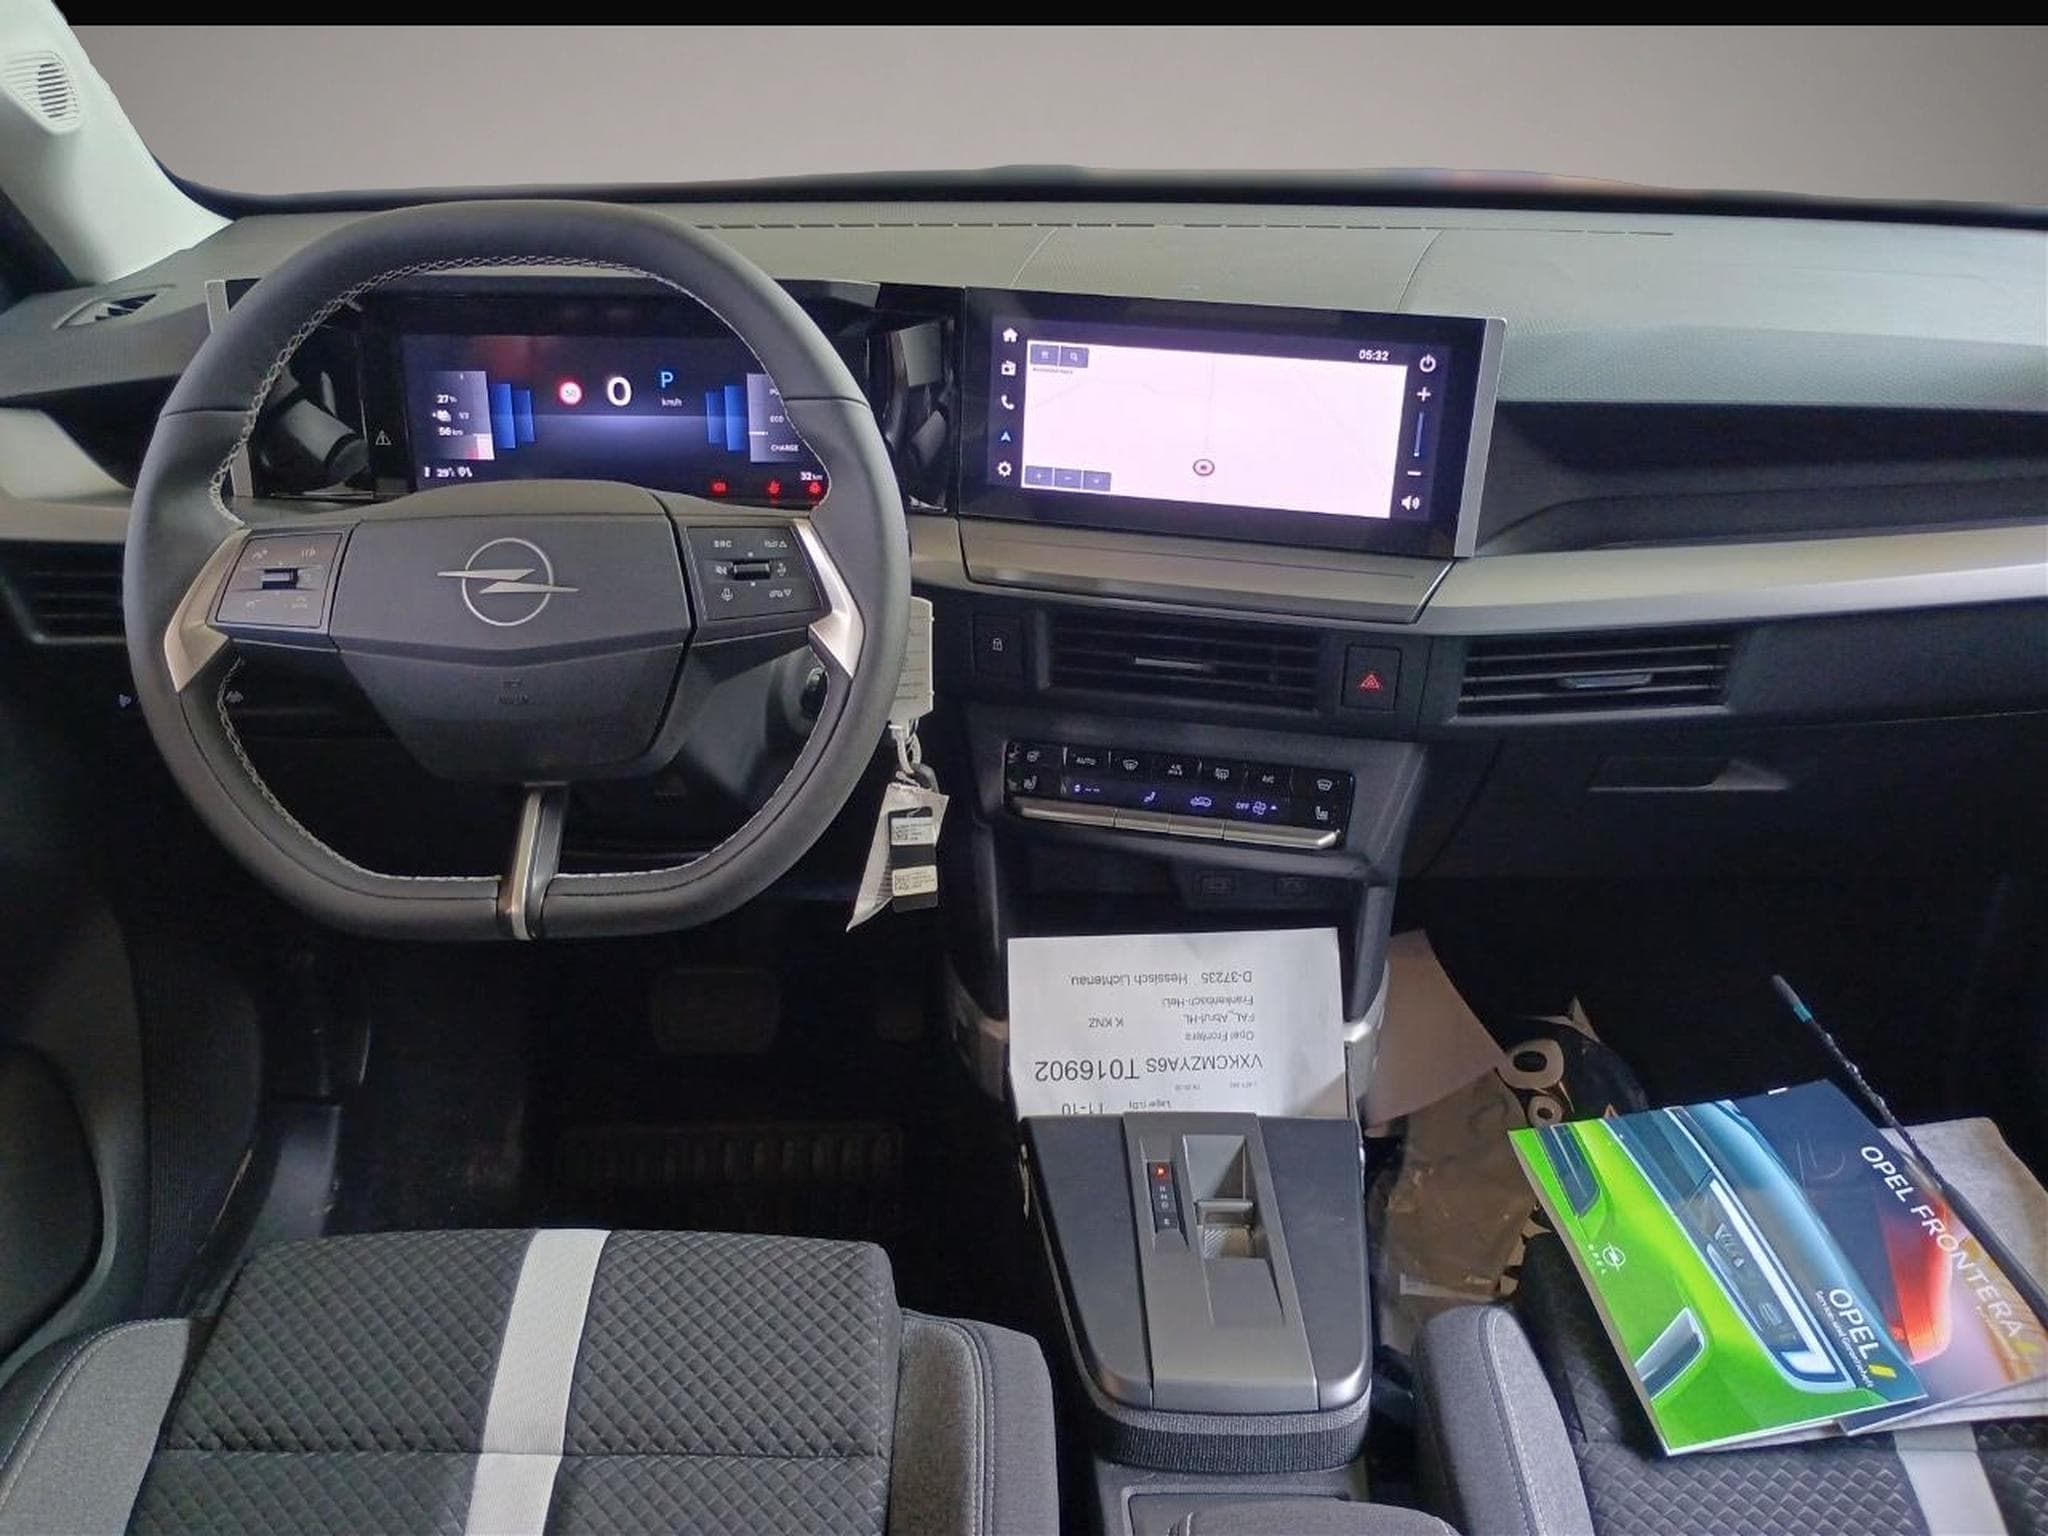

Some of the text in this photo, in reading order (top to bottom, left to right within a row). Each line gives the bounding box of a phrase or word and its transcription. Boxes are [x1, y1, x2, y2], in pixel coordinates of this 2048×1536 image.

[1358, 349, 1389, 361] 05:32
[660, 371, 674, 388] P
[606, 376, 632, 406] 0
[661, 398, 682, 407] km/h
[770, 444, 799, 452] CHARGE
[1235, 802, 1250, 810] OFF
[1133, 973, 1188, 985] Hessisch
[1200, 970, 1253, 985] D-37235
[1034, 1053, 1263, 1082] VXKCMZYA6S T016902
[1860, 1146, 1914, 1202] OPEL
[1910, 1204, 2024, 1337] FRONTERA
[1829, 1289, 1880, 1360] OPEL
